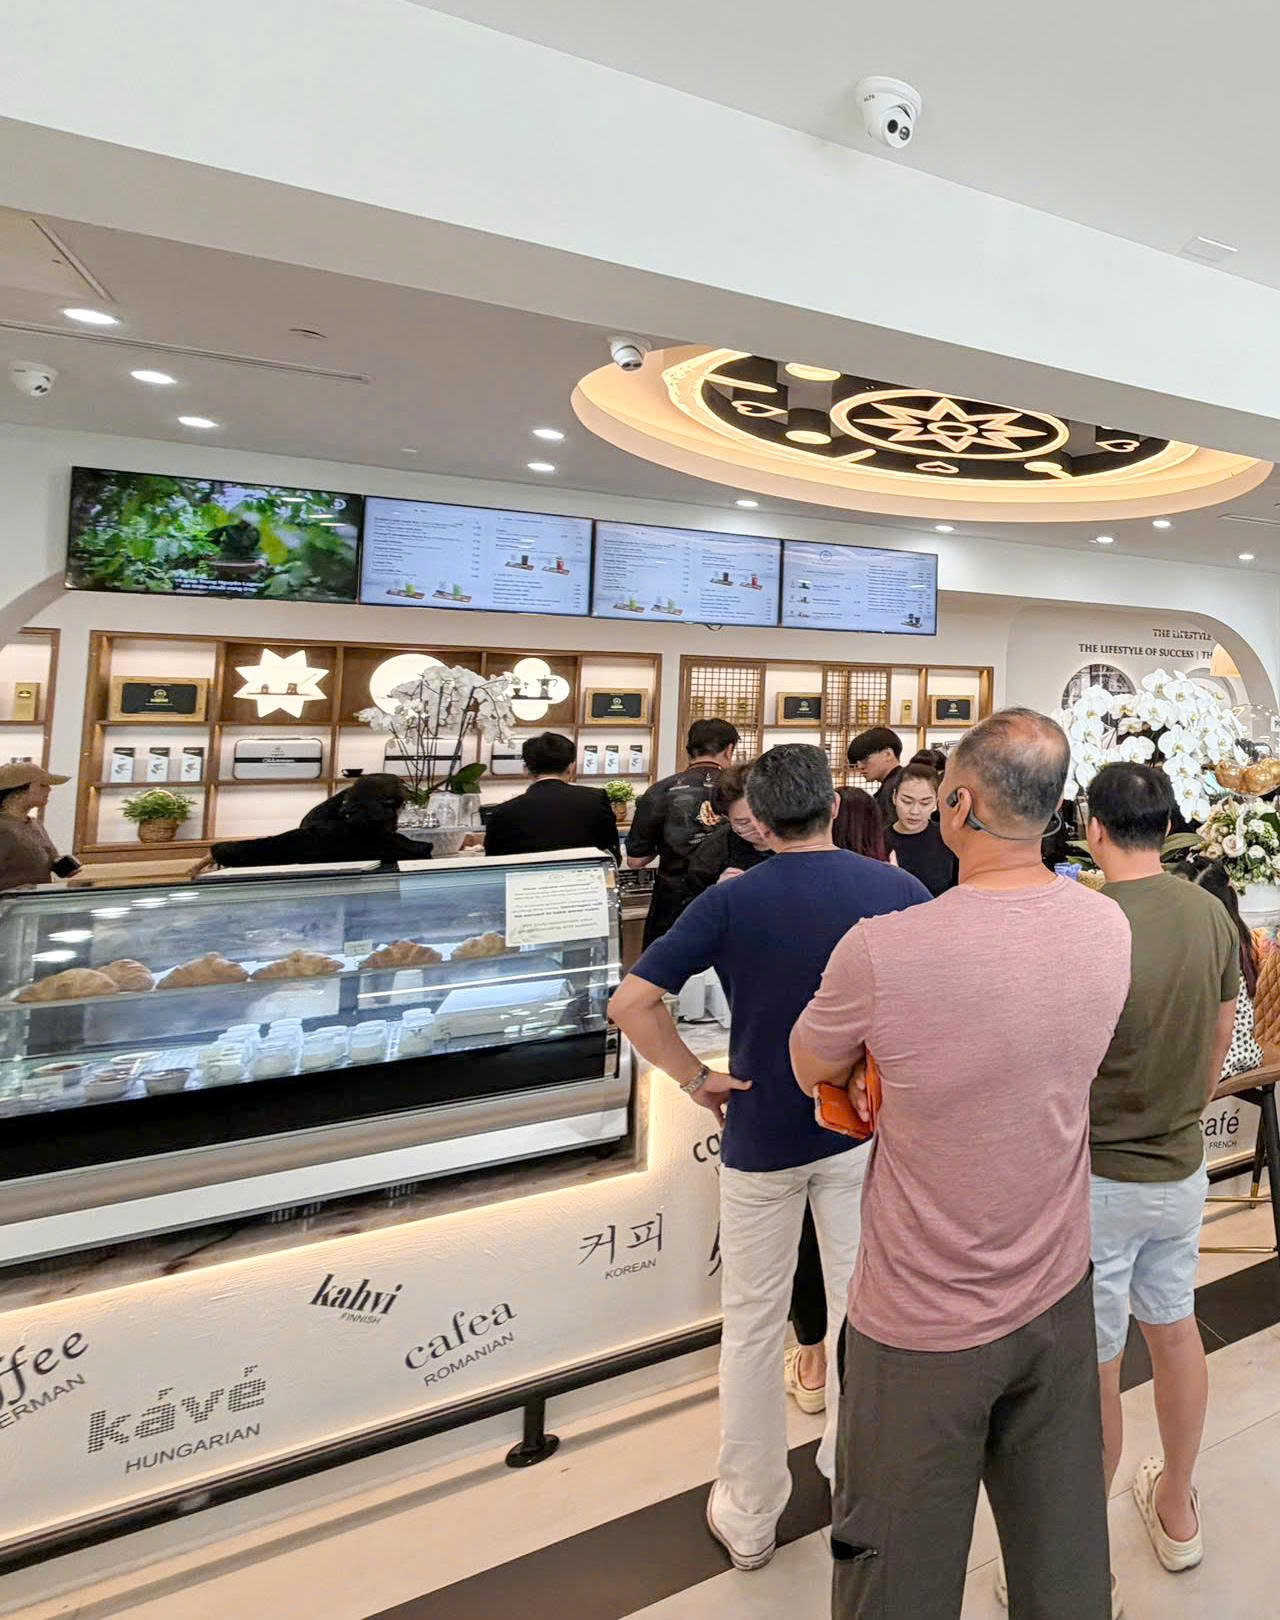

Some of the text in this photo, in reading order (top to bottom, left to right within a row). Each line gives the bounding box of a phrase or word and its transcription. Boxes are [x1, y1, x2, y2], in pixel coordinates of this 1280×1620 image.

[1078, 643, 1098, 653] THE
[1100, 645, 1142, 656] LIFESTYLE
[1144, 647, 1157, 656] OF
[1159, 648, 1194, 659] SUCCESS
[1153, 628, 1212, 641] THE LIFESTYLE
[1208, 1140, 1238, 1149] FRENCH
[577, 1212, 663, 1265] 커피
[604, 1258, 657, 1280] KOREAN
[308, 1273, 403, 1314] kahvi
[340, 1312, 382, 1325] FINNISH
[405, 1302, 518, 1370] cafea
[423, 1332, 515, 1387] ROMANIAN
[88, 1364, 266, 1454] kávé
[125, 1423, 261, 1474] HUNGARIAN
